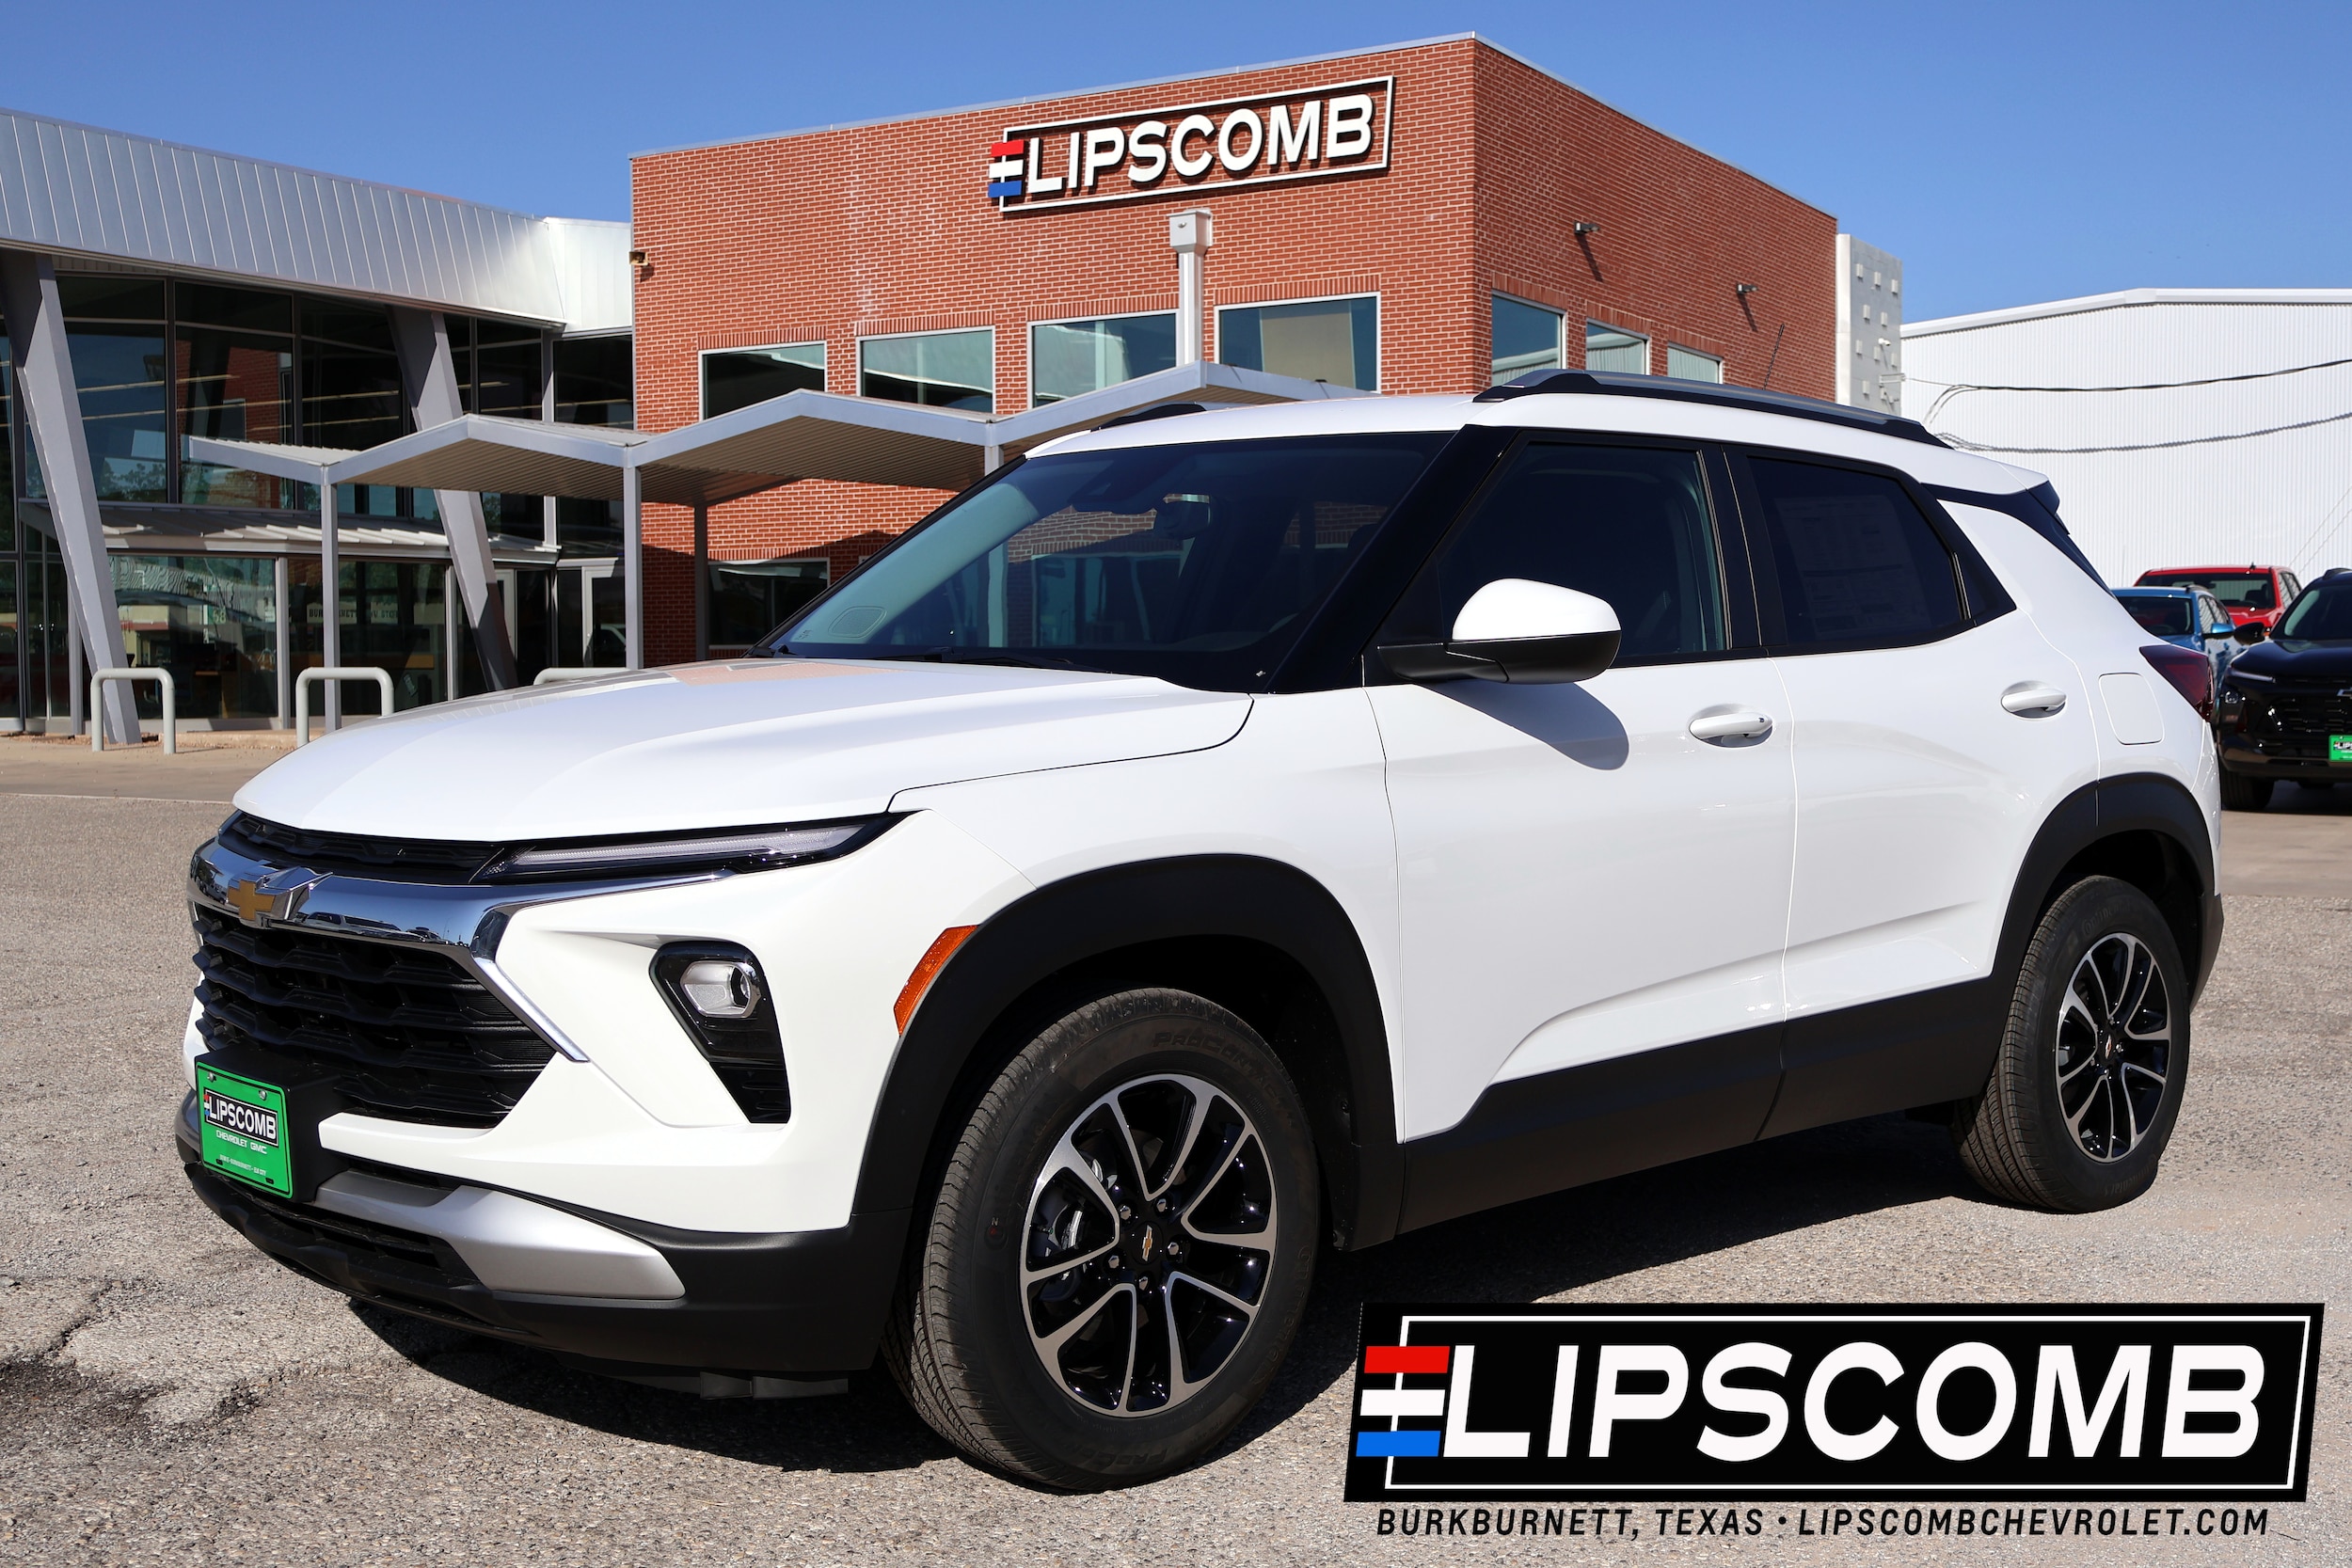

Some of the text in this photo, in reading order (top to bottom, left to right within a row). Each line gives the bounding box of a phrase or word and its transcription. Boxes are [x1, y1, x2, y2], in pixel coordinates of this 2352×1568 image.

[1027, 93, 1375, 194] LIPSCOMB
[208, 1096, 277, 1140] LIPSCOMB
[215, 1130, 268, 1154] CHEVROLET GMC
